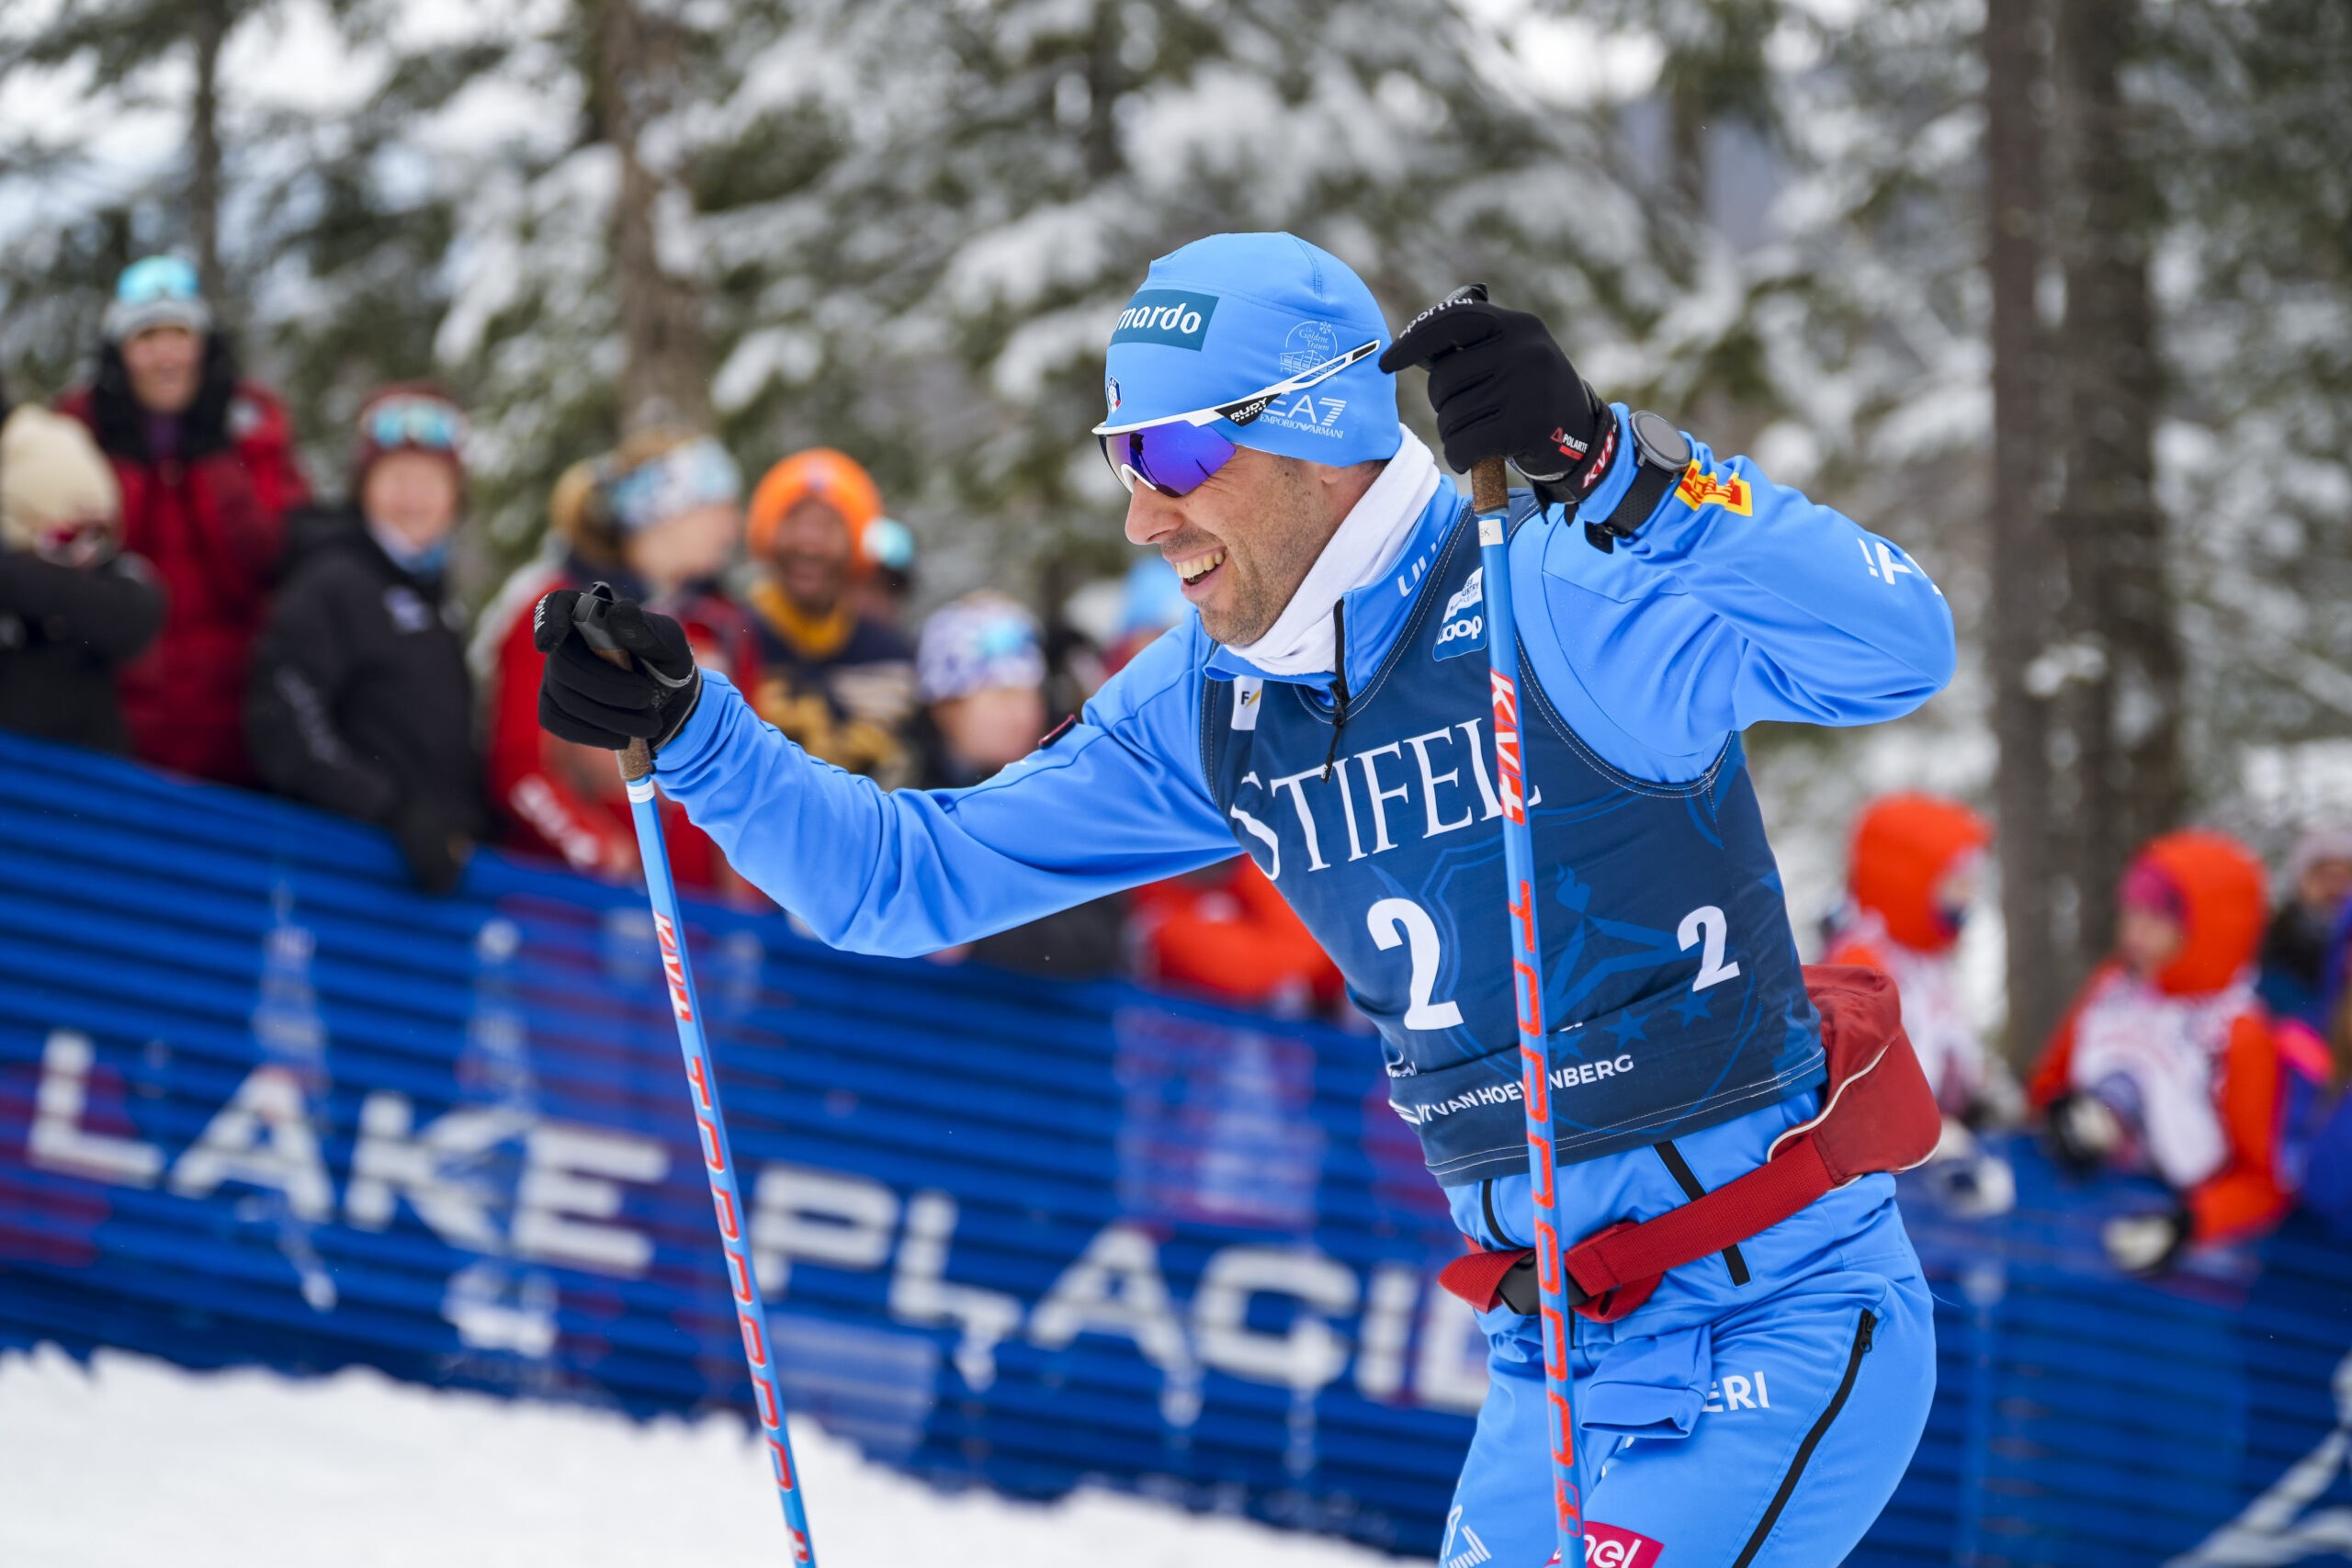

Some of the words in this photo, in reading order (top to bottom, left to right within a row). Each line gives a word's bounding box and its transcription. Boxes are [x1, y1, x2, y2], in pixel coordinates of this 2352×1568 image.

[1114, 302, 1202, 334] nardo
[1229, 397, 1267, 421] RUDY
[1230, 717, 1543, 882] STIFEL
[1367, 897, 1465, 1031] 2
[1677, 905, 1741, 992] 2
[1430, 1091, 1479, 1116] VAN
[1476, 1054, 1635, 1106] HOENBERG
[28, 1029, 669, 1277] LAKE
